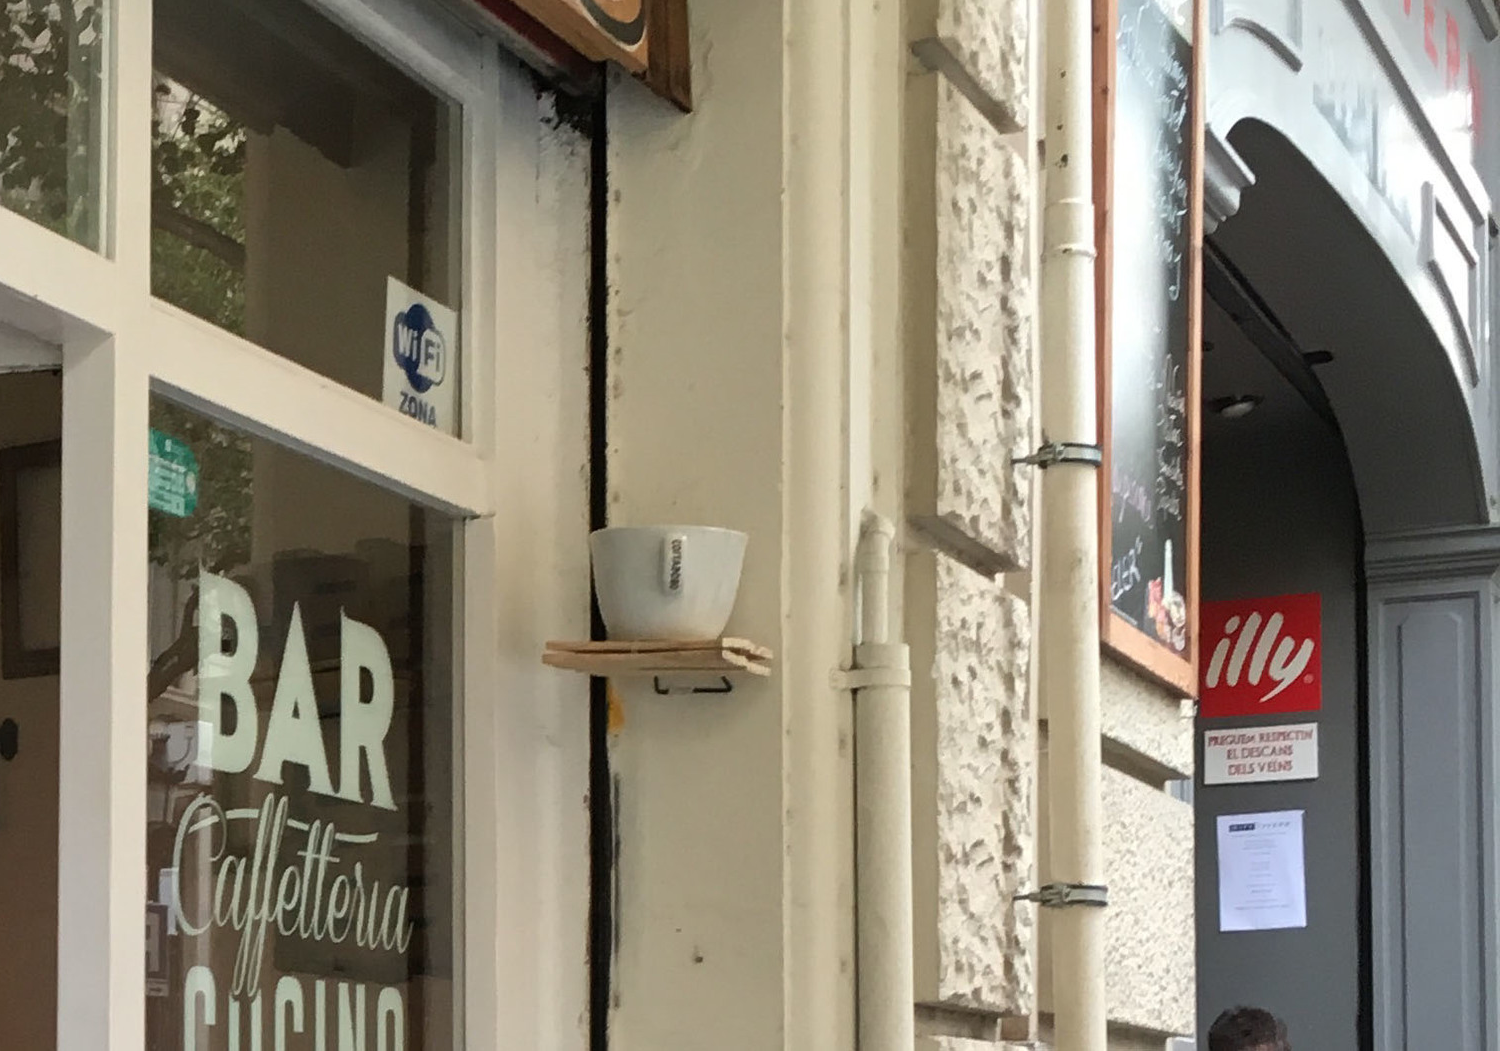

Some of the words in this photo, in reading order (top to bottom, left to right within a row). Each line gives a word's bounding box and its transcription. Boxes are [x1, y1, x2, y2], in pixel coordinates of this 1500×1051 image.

[398, 390, 438, 428] ZONA
[196, 561, 398, 811] BAR
[1205, 610, 1316, 704] illy
